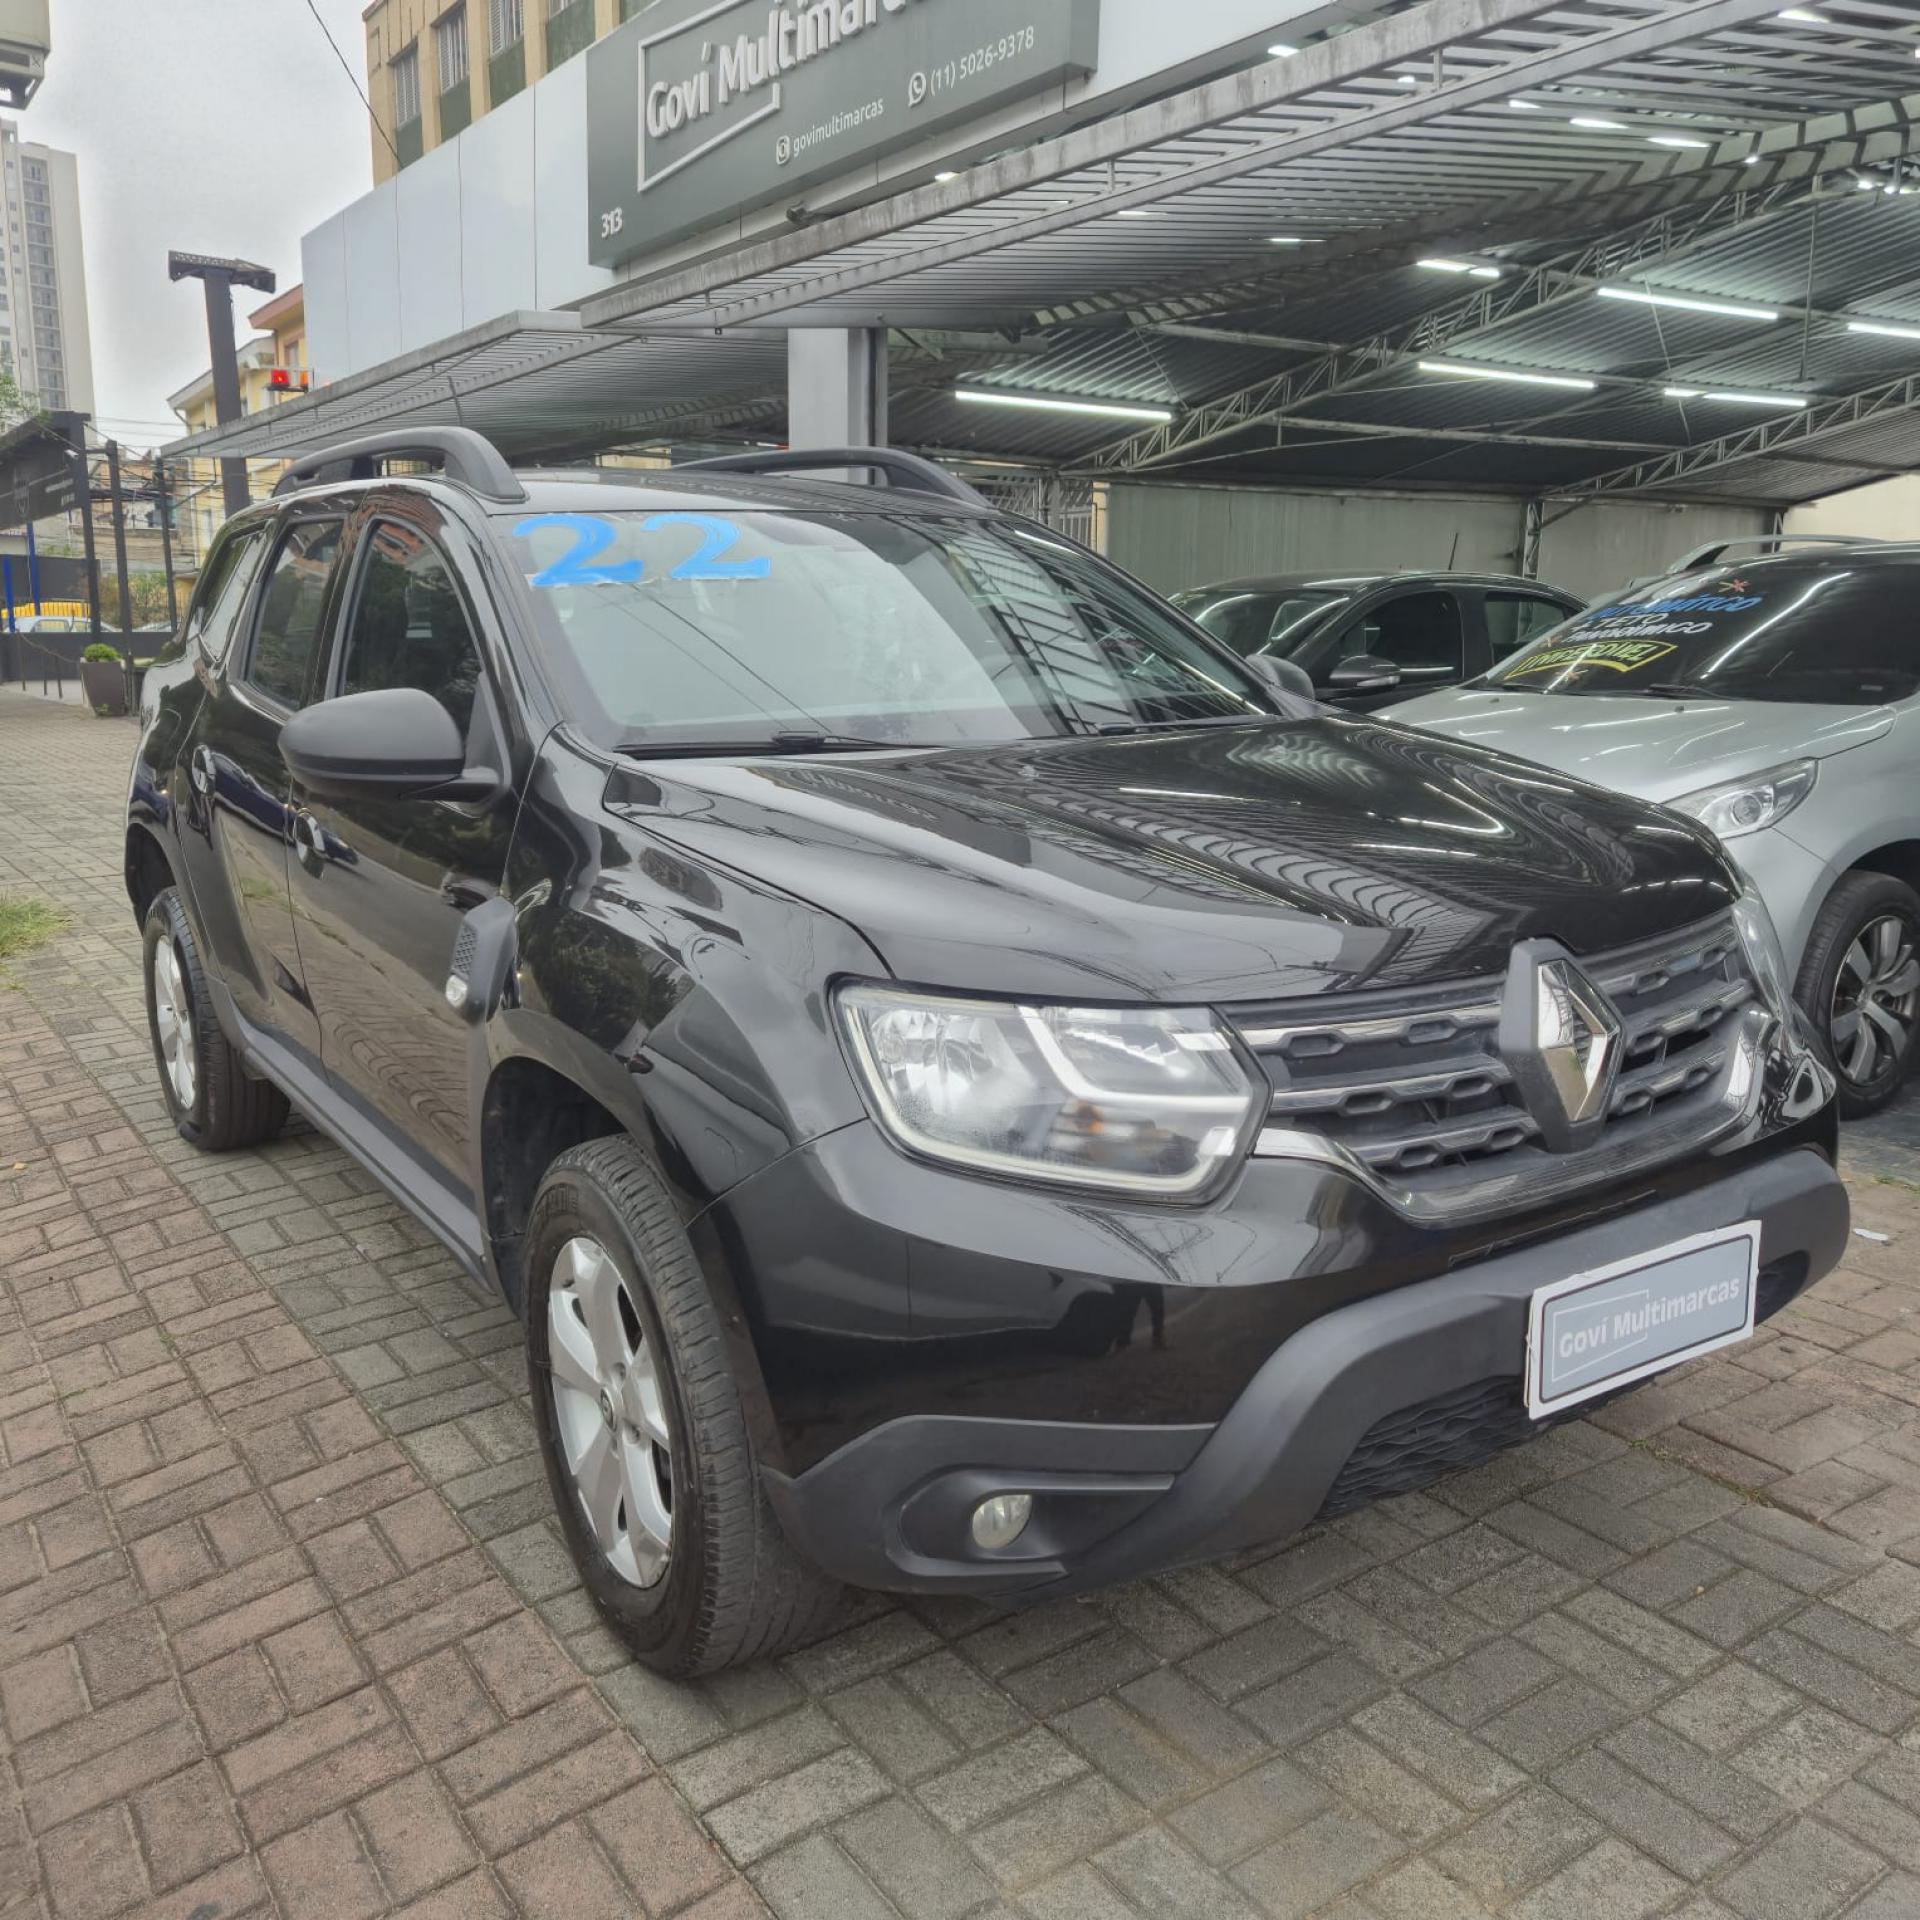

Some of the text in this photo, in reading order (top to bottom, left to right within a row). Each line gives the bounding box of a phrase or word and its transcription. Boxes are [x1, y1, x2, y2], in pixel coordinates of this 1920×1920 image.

[718, 0, 906, 104] Multimar
[930, 25, 1034, 97] (11) 5026-9378
[793, 98, 884, 158] govimultimarcas
[601, 207, 623, 238] 313
[512, 512, 773, 588] 22
[1594, 612, 1669, 630] TETO
[1613, 1277, 1741, 1340] Multimarcas
